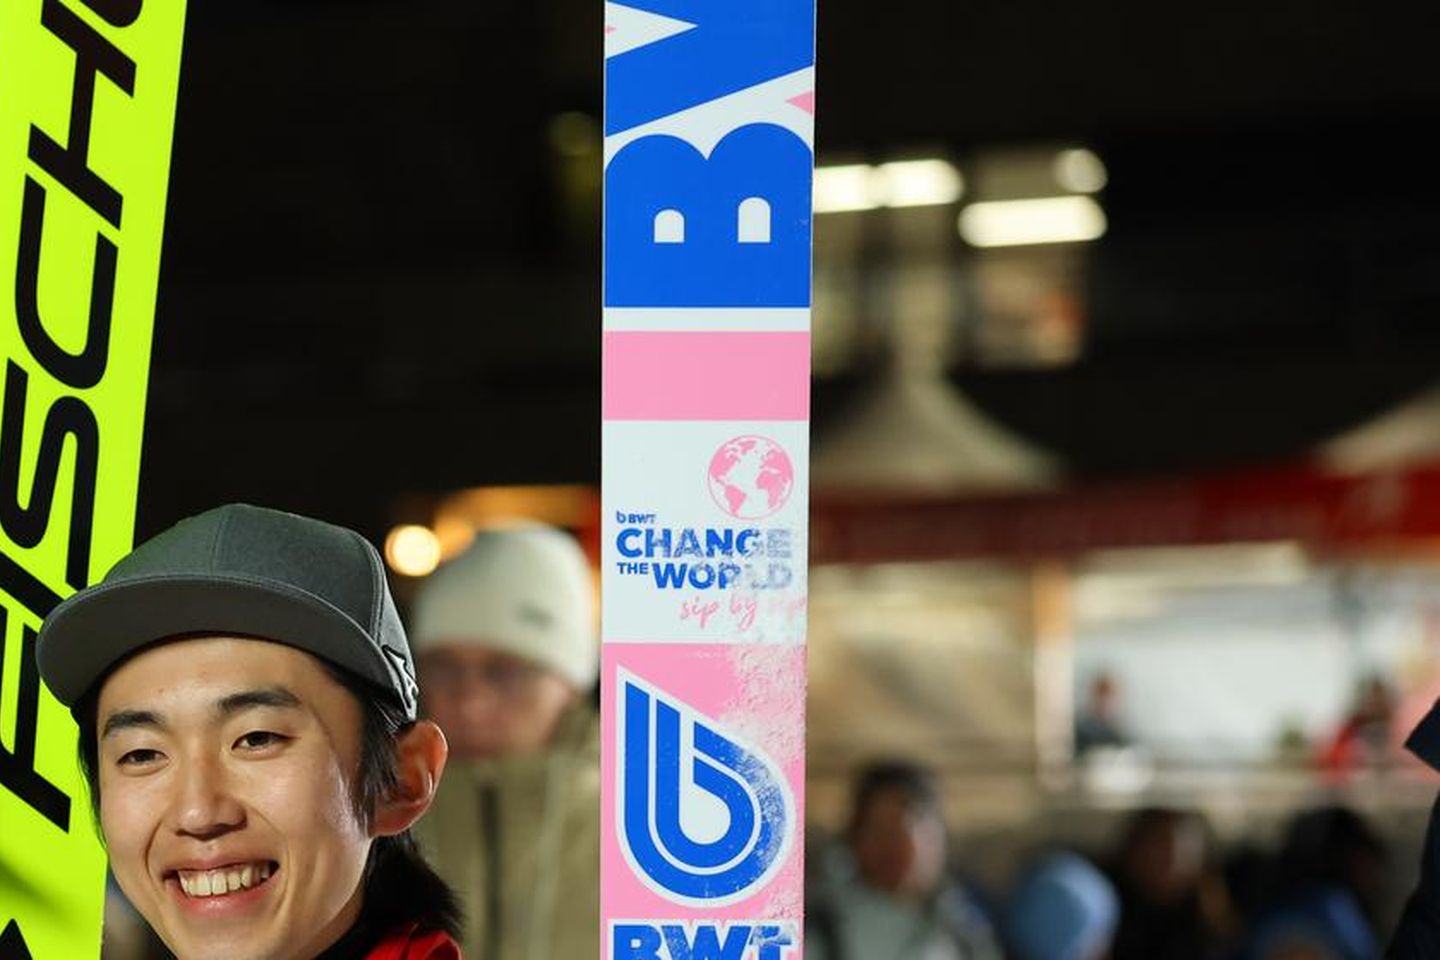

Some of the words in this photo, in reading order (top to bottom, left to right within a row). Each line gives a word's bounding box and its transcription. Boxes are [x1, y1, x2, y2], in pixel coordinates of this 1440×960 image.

[616, 528, 792, 558] CHANGE
[617, 562, 648, 575] THE
[652, 563, 792, 590] WORD
